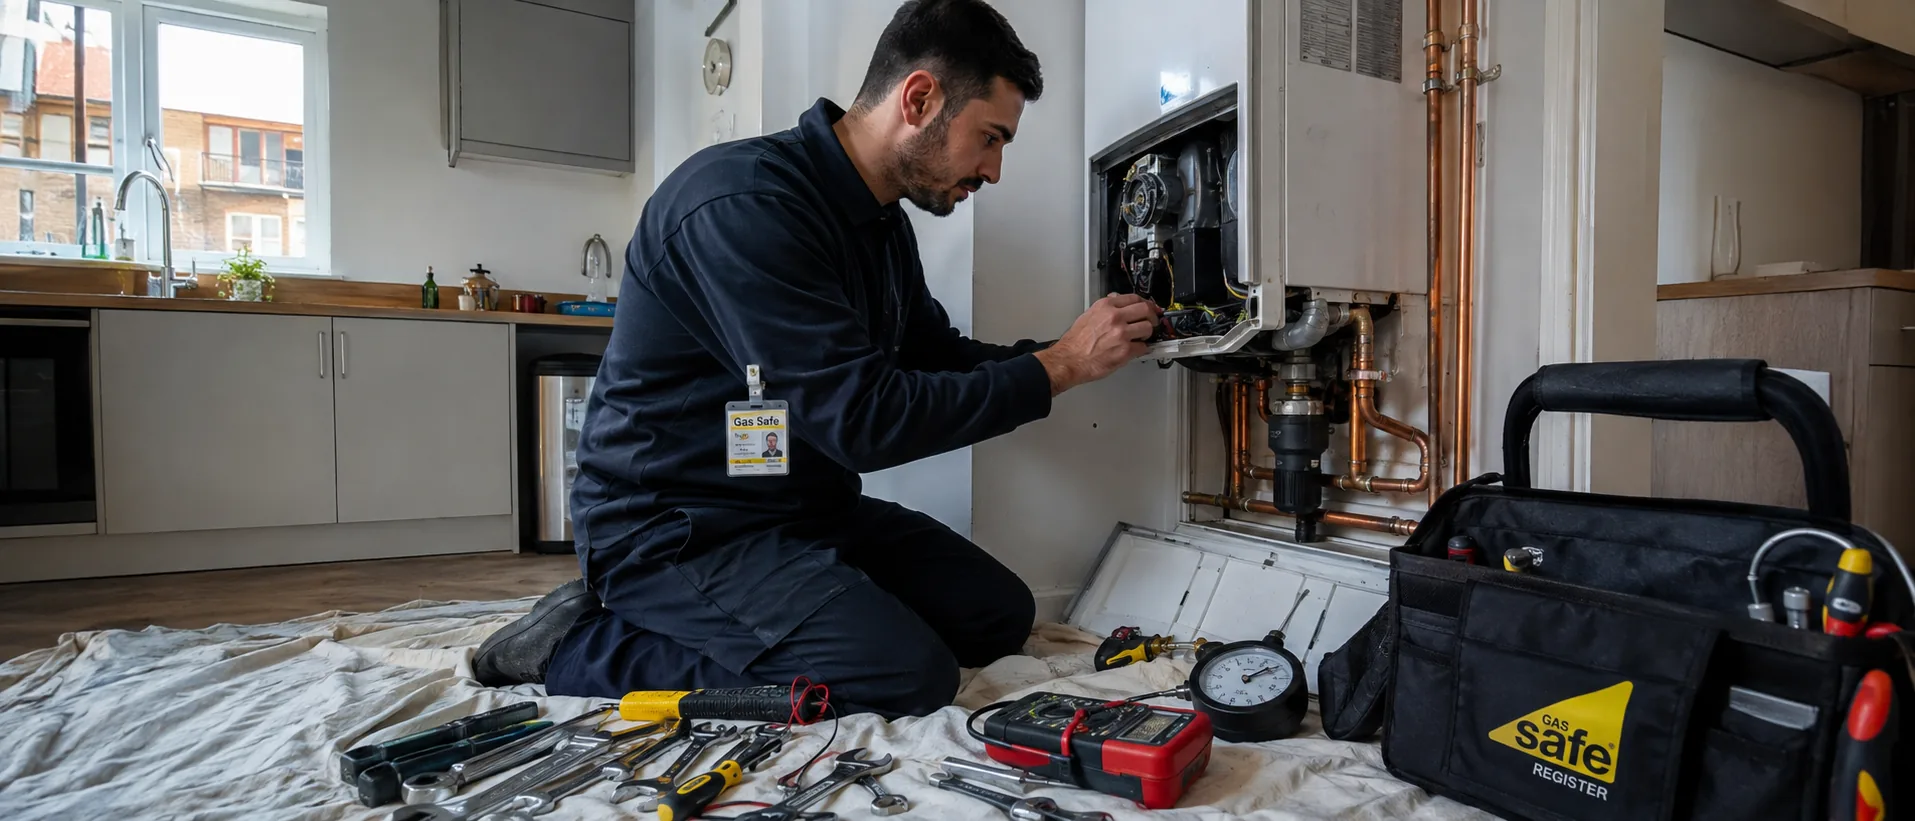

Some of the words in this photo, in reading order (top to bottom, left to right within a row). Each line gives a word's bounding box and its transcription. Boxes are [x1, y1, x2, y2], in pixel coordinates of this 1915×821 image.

[733, 417, 754, 427] Gas
[757, 416, 780, 426] Safe
[1542, 714, 1569, 732] GAS
[1515, 720, 1611, 775] safe
[1533, 763, 1608, 801] REGISTER
